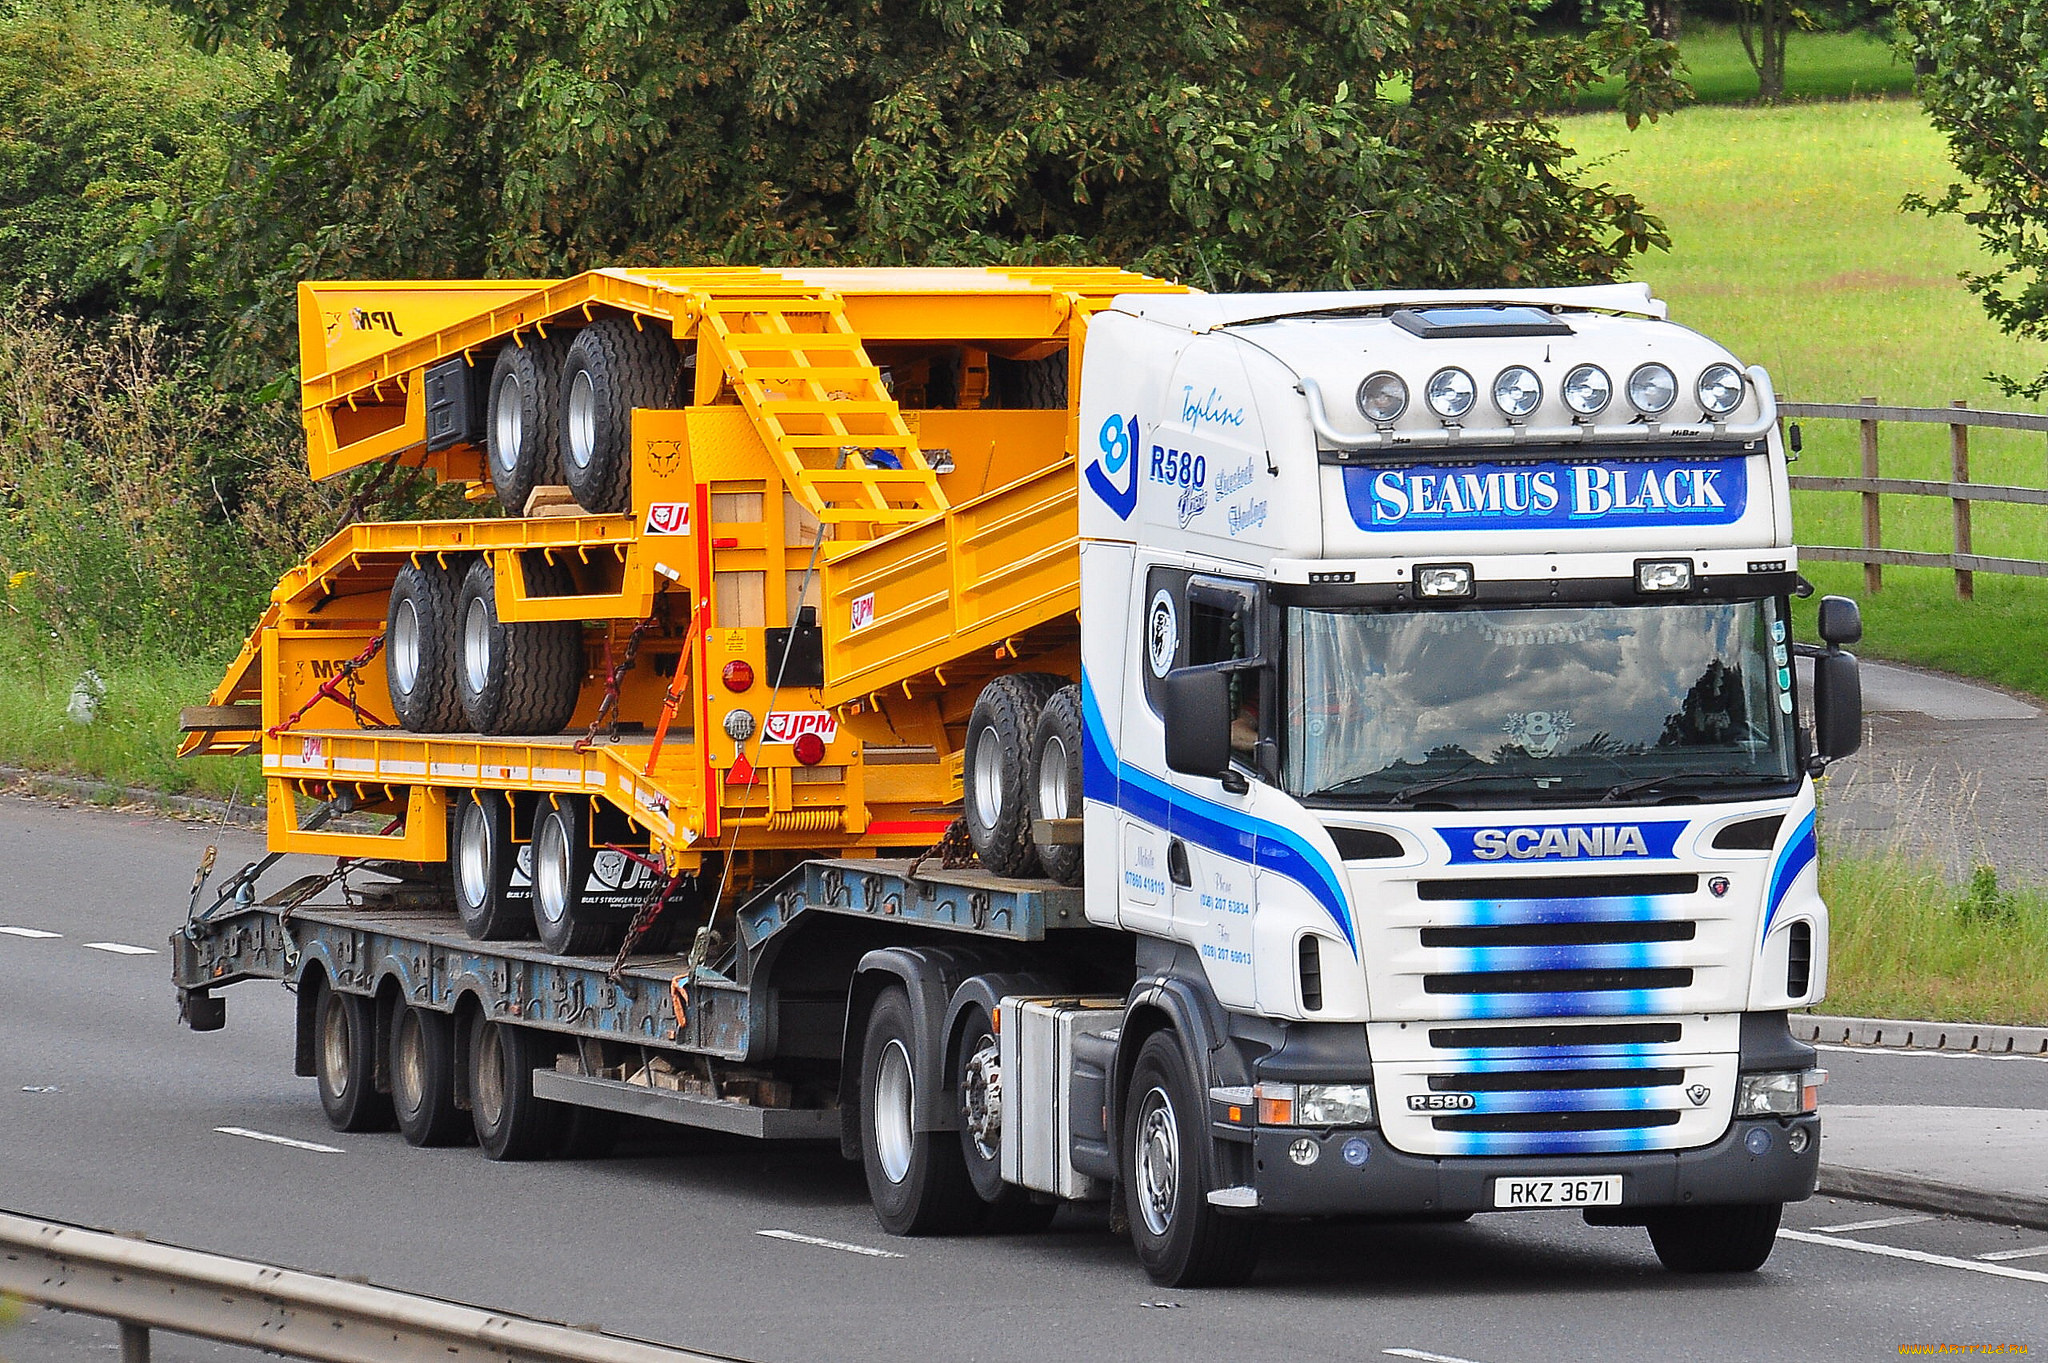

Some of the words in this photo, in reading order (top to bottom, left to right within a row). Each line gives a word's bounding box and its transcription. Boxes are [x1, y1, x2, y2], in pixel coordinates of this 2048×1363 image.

[1182, 385, 1245, 433] Topline
[1150, 445, 1206, 492] R580
[1372, 467, 1560, 523] SEAMUS
[1570, 466, 1726, 520] BLACK
[785, 714, 835, 740] JPM
[1472, 825, 1648, 861] SCANIA
[1215, 897, 1227, 910] 207
[1218, 947, 1229, 961] 207
[1410, 1095, 1474, 1109] R580
[1511, 1183, 1553, 1203] RKZ
[1560, 1181, 1609, 1201] 3671
